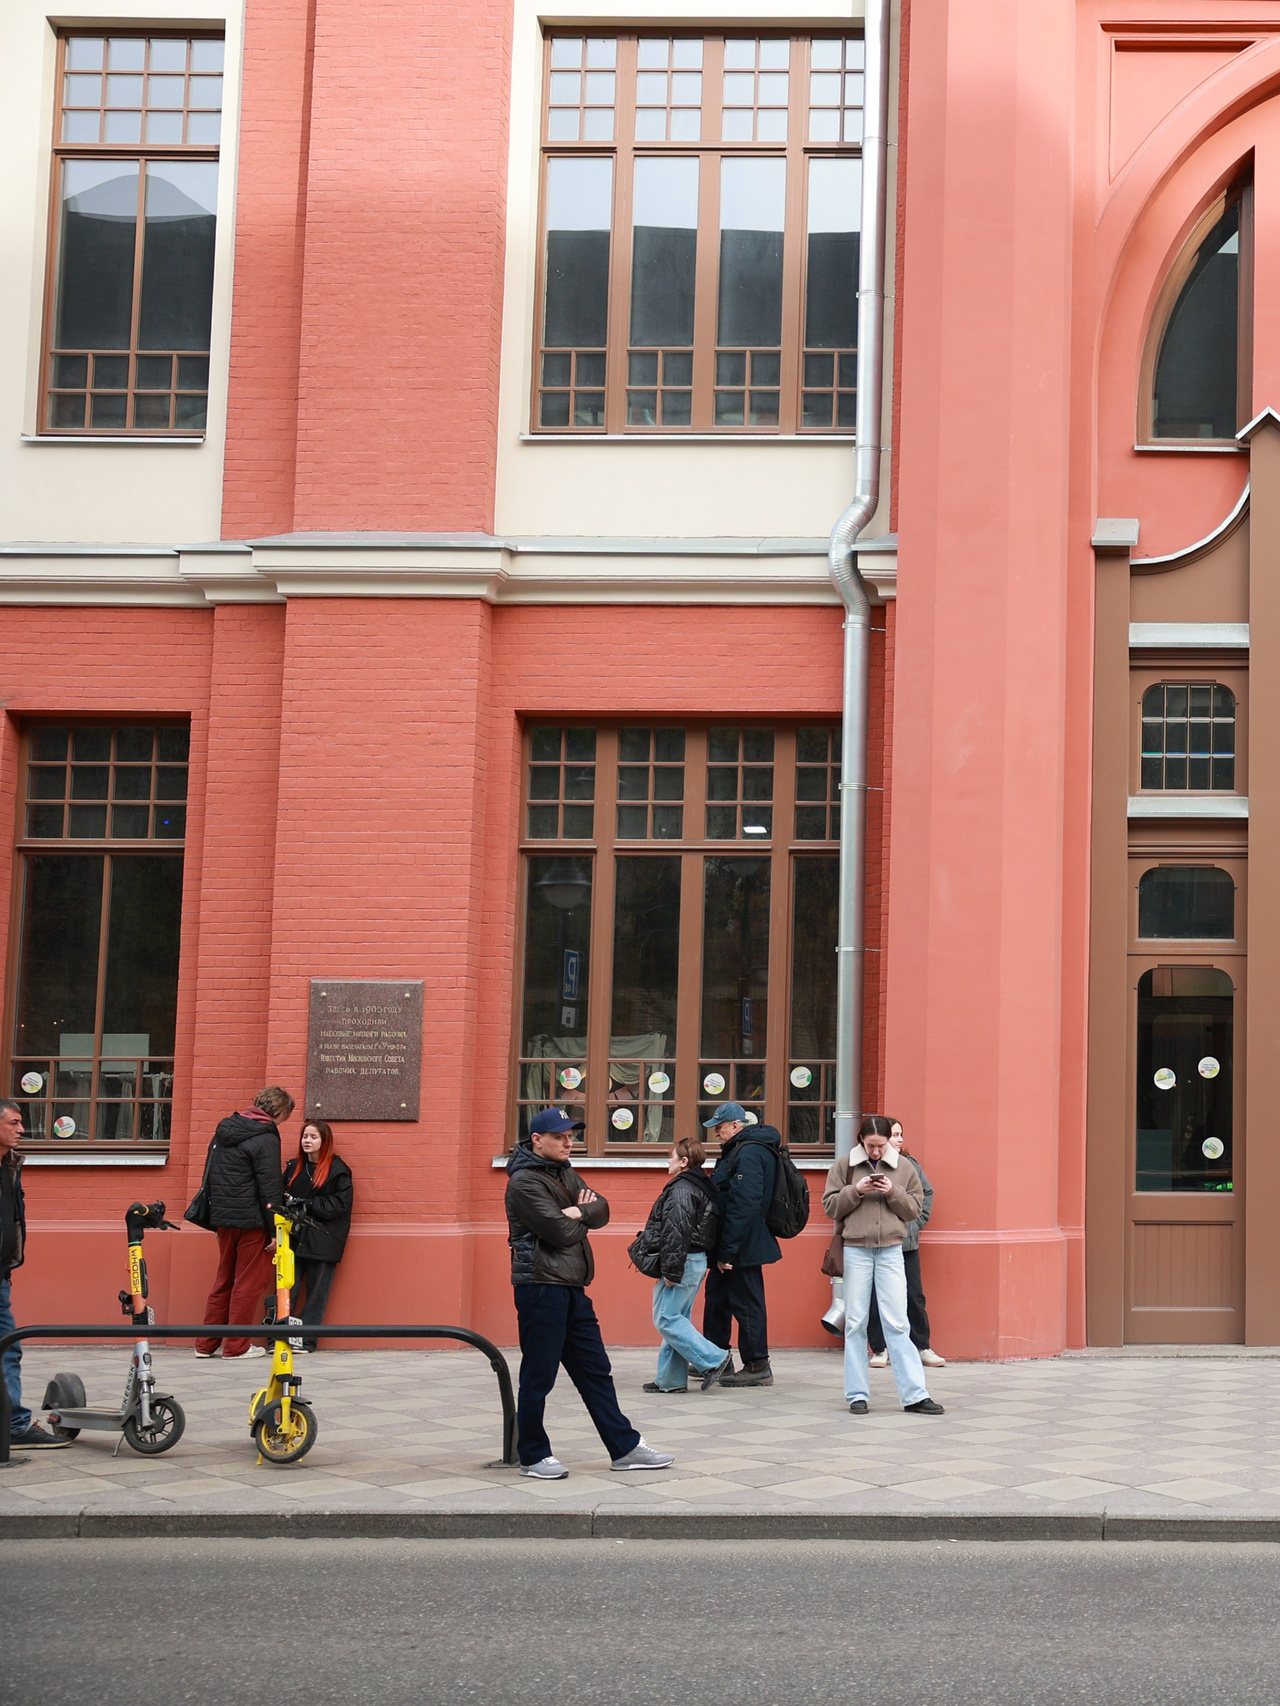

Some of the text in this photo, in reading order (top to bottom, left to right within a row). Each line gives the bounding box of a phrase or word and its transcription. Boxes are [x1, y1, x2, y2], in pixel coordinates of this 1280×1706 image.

[327, 1005, 351, 1014] ЗДЕСЬ
[362, 1005, 383, 1014] 1905
[383, 1006, 403, 1014] ГОДУ
[342, 1018, 387, 1026] ПРОХОДИЛИ
[320, 1030, 407, 1038] МАССОВЫЕ МИТИНГИ РАБОЧИХ
[384, 1054, 406, 1063] СОВЕТА
[325, 1067, 357, 1075] РАБОЧИХ
[131, 1248, 141, 1294] WHOOSH
